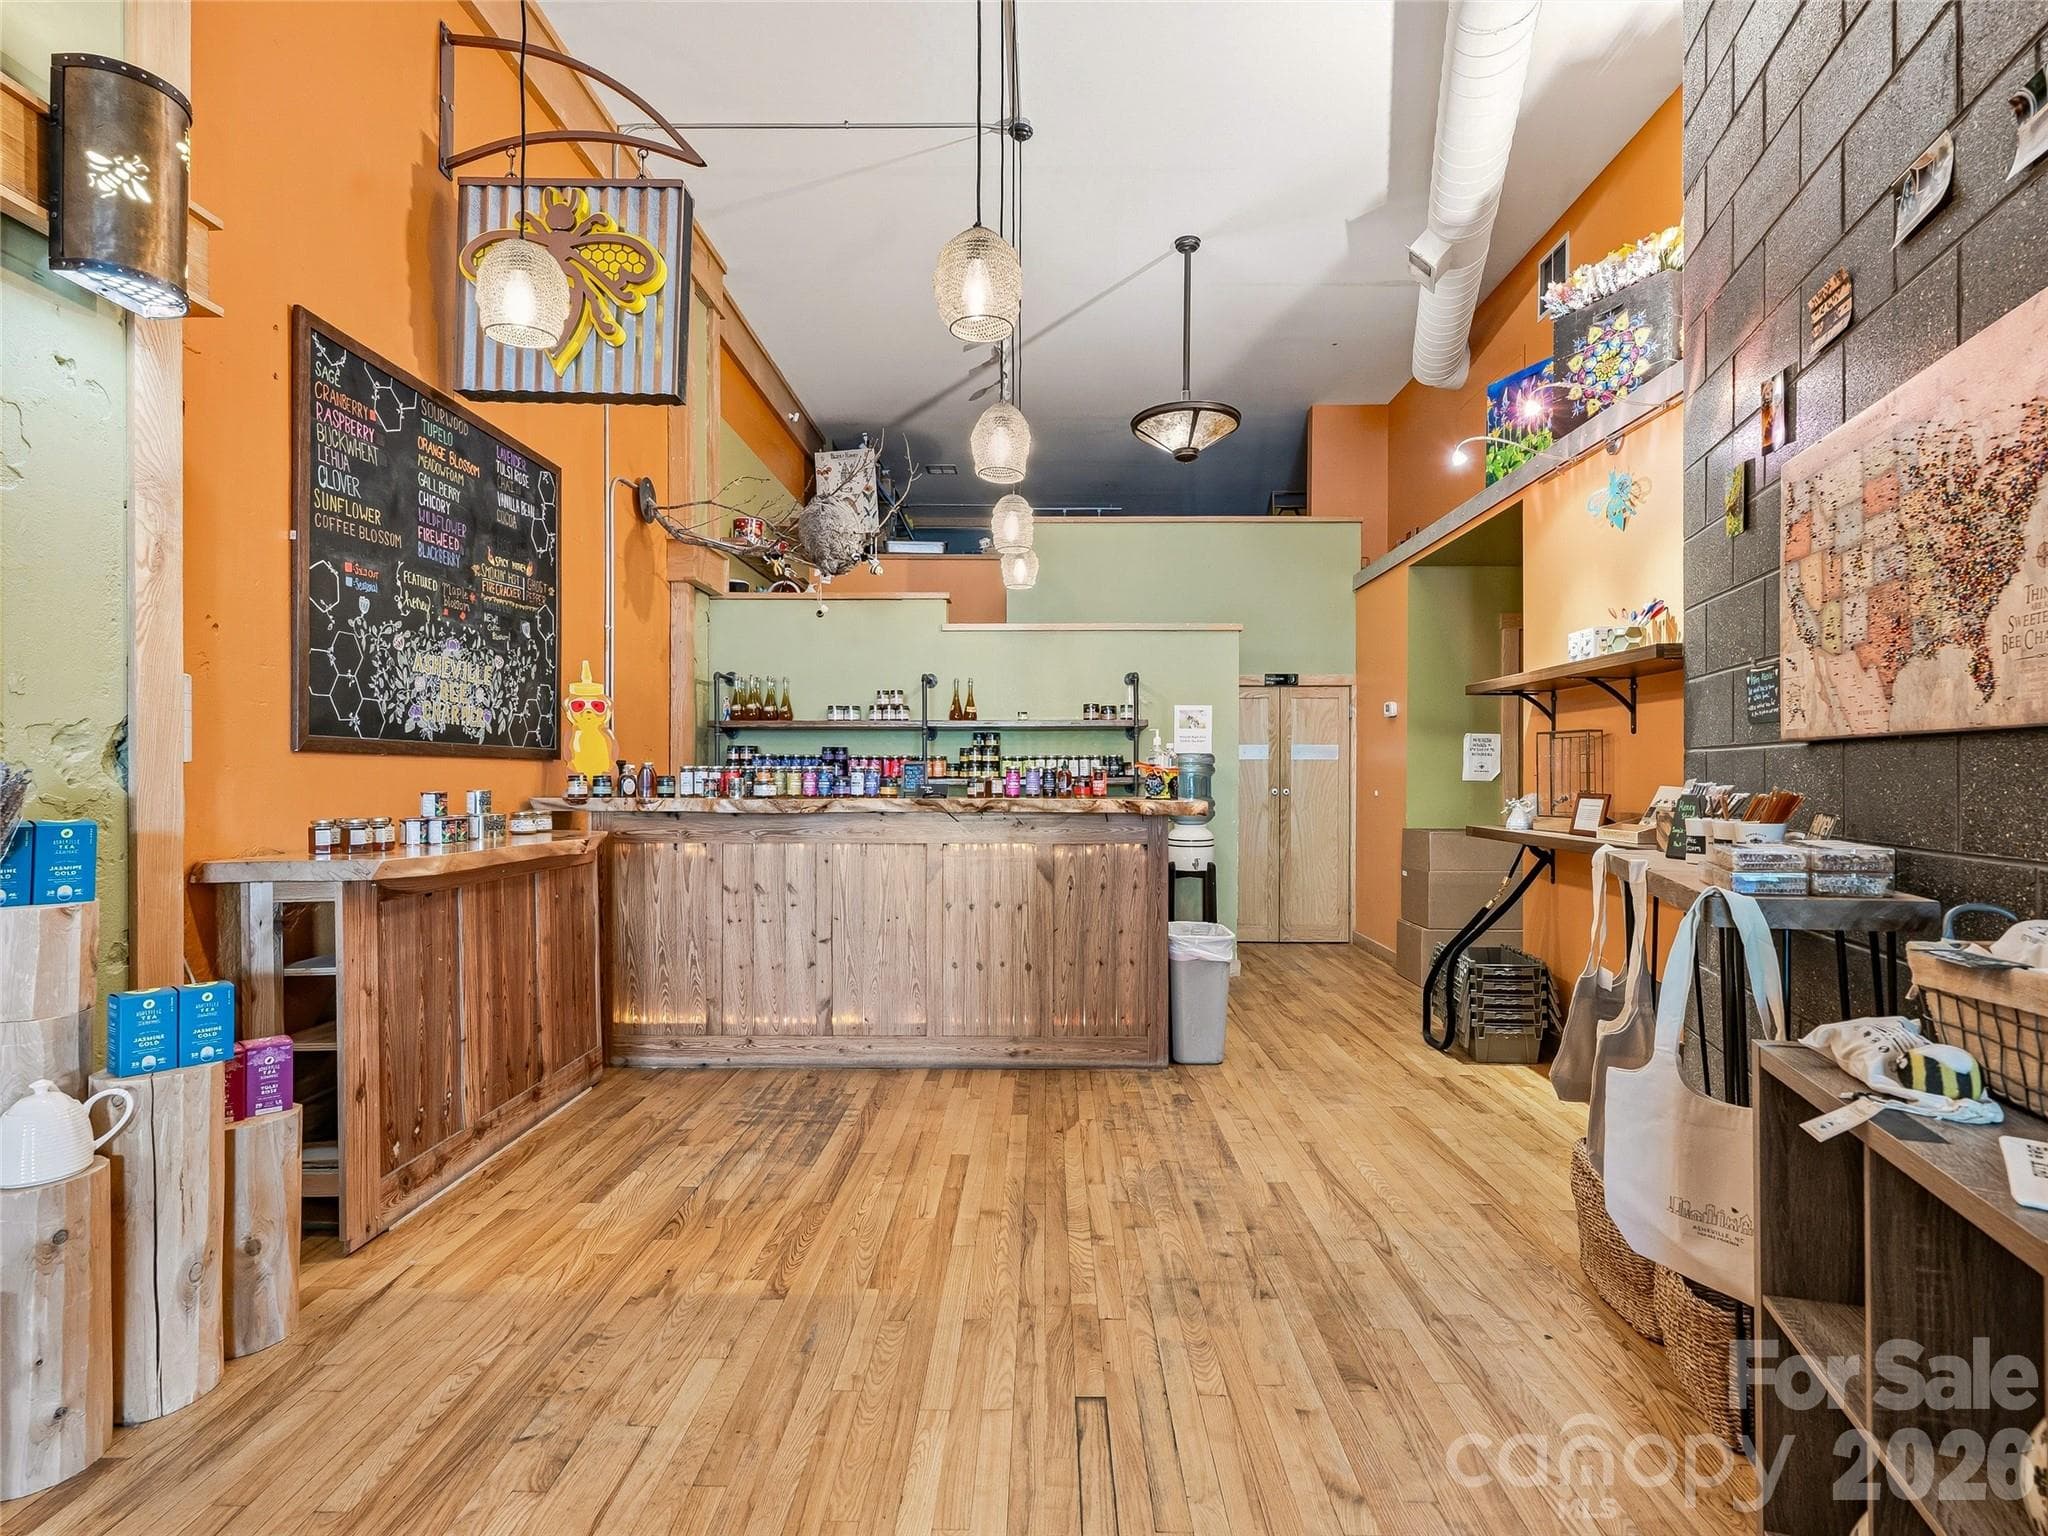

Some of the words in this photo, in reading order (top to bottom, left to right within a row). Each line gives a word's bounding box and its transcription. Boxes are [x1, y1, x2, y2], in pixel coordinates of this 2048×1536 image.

[315, 361, 341, 388] SAGE
[314, 381, 368, 421] CRANBERRY
[316, 401, 375, 443] RASPBERRY
[420, 398, 469, 436] SOURWOOD
[316, 423, 379, 466] BUCKWHEAT
[421, 418, 454, 447] TUPELO
[317, 444, 350, 472] LEHUA
[417, 435, 447, 462] ORANGE
[449, 451, 480, 478] BLOSSOM
[417, 454, 465, 487] MEADOWFOAM
[496, 445, 528, 472] LAVENDER
[317, 465, 361, 499] CLOVER
[417, 471, 462, 503] GALLBERRY
[496, 460, 514, 481] TULSI
[514, 467, 530, 489] ROSE
[314, 488, 381, 526] SUNFLOWER
[418, 490, 451, 516] CHICORY
[497, 491, 521, 516] VANILLA
[521, 499, 536, 519] BEAN
[315, 513, 356, 537] COFFEE
[359, 525, 402, 549] BLOSSOM
[418, 508, 467, 539] WILDFLOWER
[496, 509, 518, 530] COCOA
[418, 526, 460, 551] FIREWEED
[417, 541, 462, 568] BLACKBERRY
[403, 569, 438, 592] FEATURED
[482, 580, 521, 600] FIRECRACKER
[508, 572, 520, 585] HOT
[2002, 634, 2021, 655] BEE
[412, 652, 493, 686] ASHEVILLE
[439, 680, 470, 705] BEE
[133, 1034, 165, 1043] JASMINE
[193, 1025, 222, 1034] JASMINE
[138, 1040, 160, 1048] GOLD
